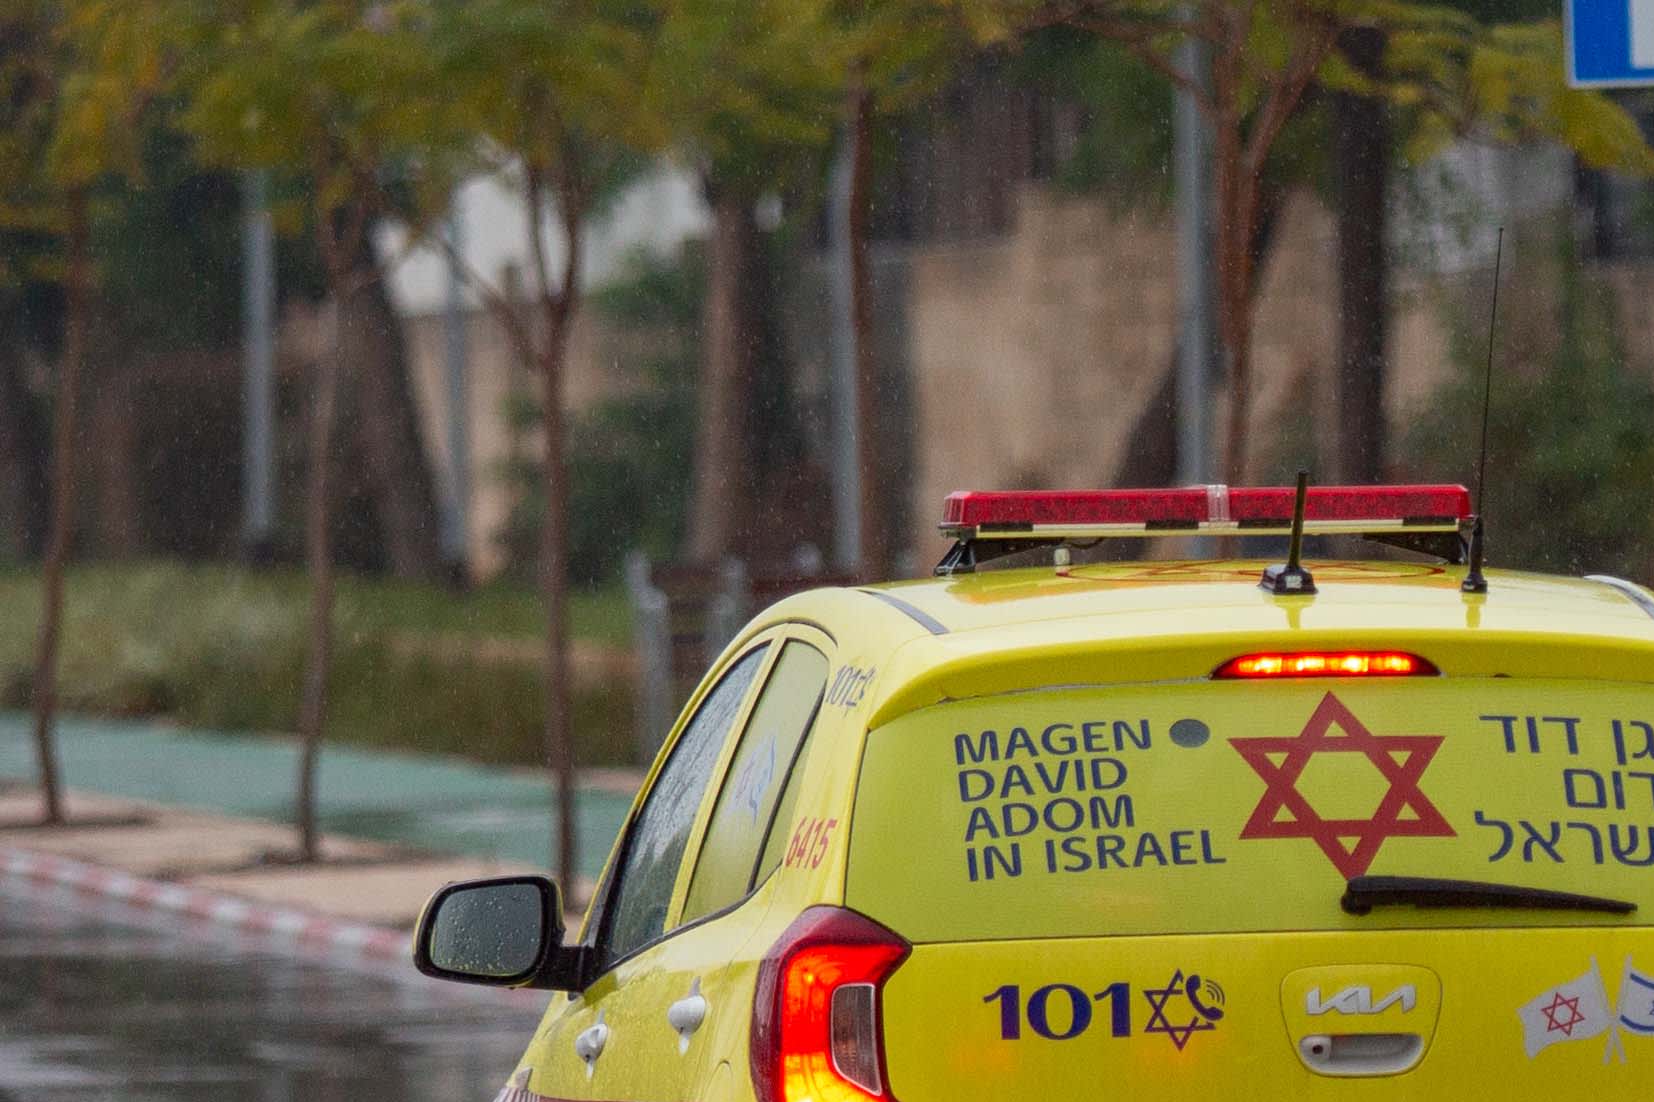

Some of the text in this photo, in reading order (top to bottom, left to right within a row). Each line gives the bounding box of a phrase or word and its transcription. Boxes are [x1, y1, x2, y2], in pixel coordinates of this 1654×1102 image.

[953, 719, 1152, 765] MAGEN
[1479, 715, 1581, 756] דוד
[958, 756, 1129, 803] DAVID
[964, 794, 1135, 842] ADOM
[785, 816, 838, 870] 6415
[967, 829, 1228, 882] IN ISRAEL
[983, 984, 1132, 1041] 101
